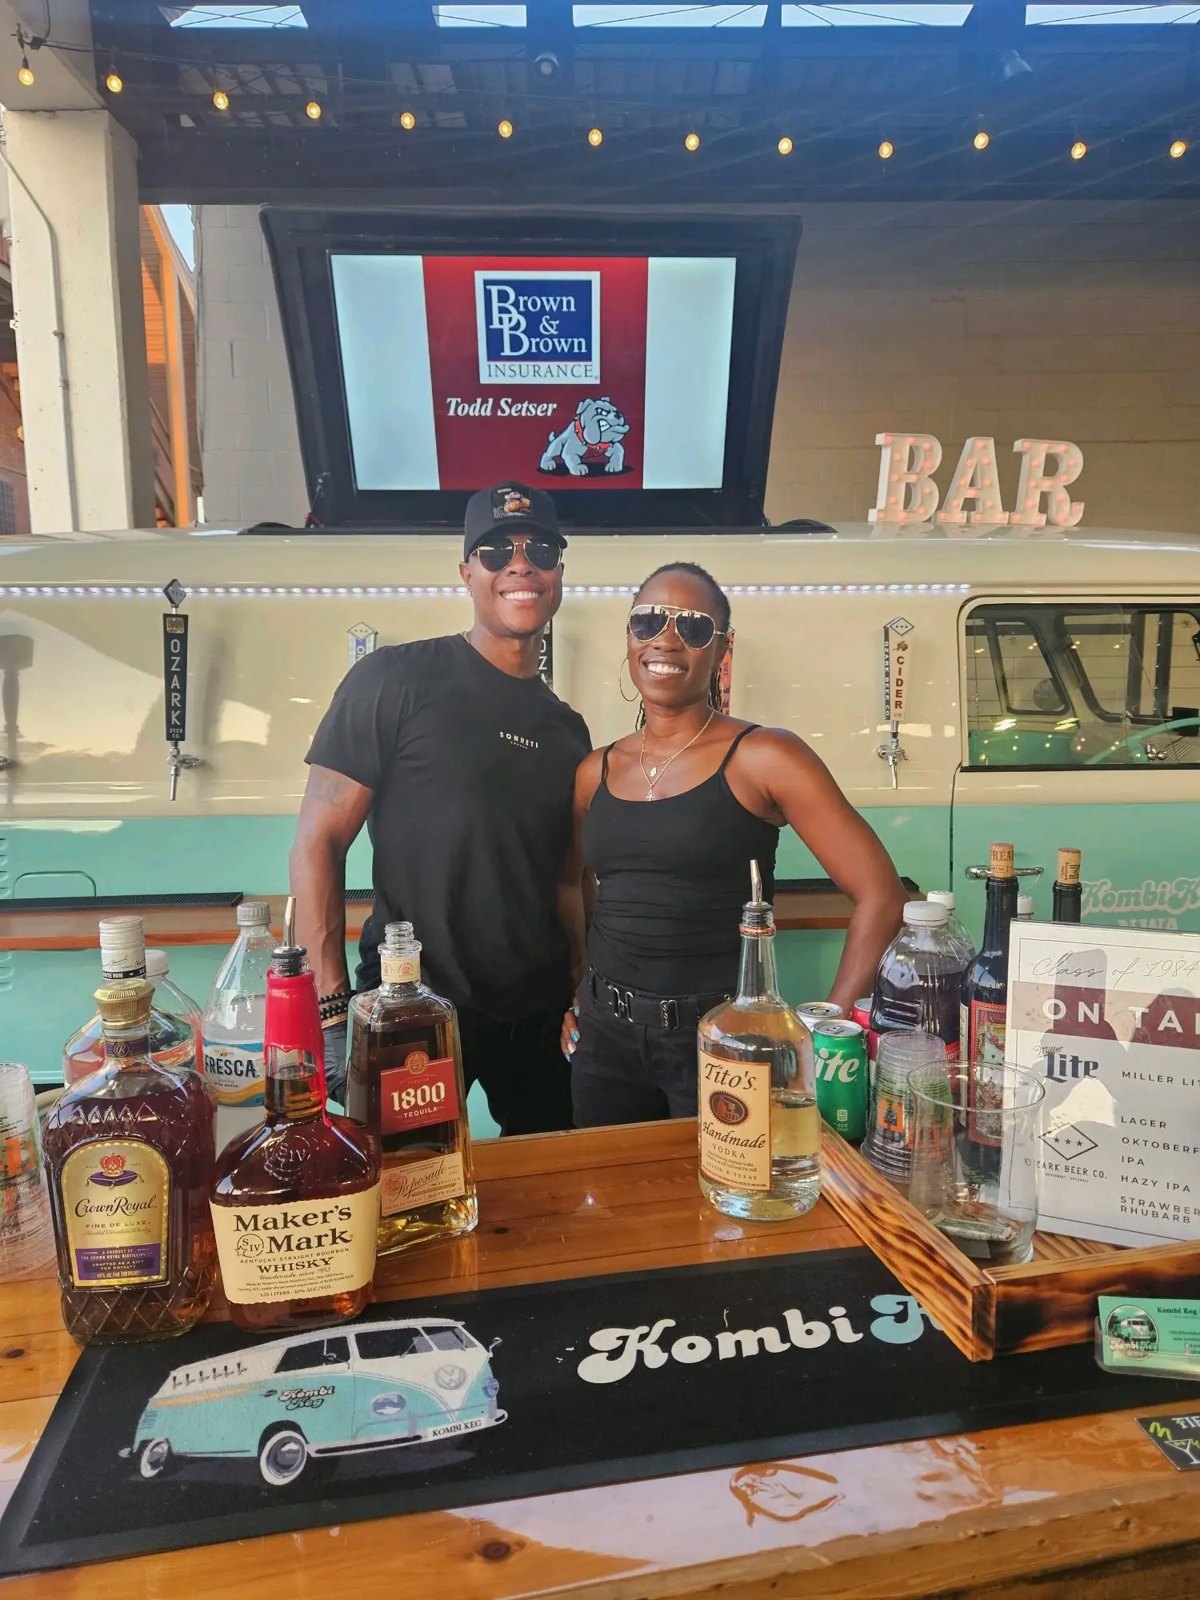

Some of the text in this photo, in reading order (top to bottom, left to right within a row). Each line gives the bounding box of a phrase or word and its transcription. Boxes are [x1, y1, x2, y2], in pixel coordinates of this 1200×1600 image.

[486, 285, 576, 329] Brown
[500, 313, 587, 356] Brown
[539, 315, 560, 335] &
[487, 364, 593, 378] INSURANCE
[446, 398, 557, 417] Todd Setser
[868, 432, 1085, 527] BAR
[170, 639, 181, 725] OZARK
[894, 656, 905, 709] CIDER
[1081, 878, 1167, 916] Kombi
[1032, 951, 1104, 977] Class
[1111, 957, 1140, 989] of
[1042, 998, 1200, 1035] ON TA
[1033, 1045, 1063, 1057] Miller
[205, 1054, 256, 1078] FRESCA
[704, 1062, 756, 1090] Tito's
[814, 1048, 860, 1083] ite
[1044, 1052, 1100, 1083] Lite
[1122, 1071, 1174, 1084] MILLER
[391, 1082, 445, 1111] 1800
[403, 1107, 438, 1118] TEQUILA
[1121, 1116, 1167, 1129] LAGER
[703, 1121, 766, 1149] Handmade
[712, 1143, 746, 1159] VODKA
[1121, 1155, 1145, 1166] IPA
[1064, 1165, 1088, 1177] BEER
[1092, 1169, 1109, 1180] CO.
[1121, 1175, 1191, 1193] HAZY IPA
[75, 1194, 157, 1218] Crown Royal
[1120, 1205, 1191, 1224] RHUBARB
[233, 1205, 352, 1232] Maker's
[266, 1227, 352, 1254] Mark
[257, 1257, 334, 1274] WHISKY
[279, 1253, 313, 1262] STRAIGHT
[316, 1248, 350, 1257] BOURBON
[1183, 1307, 1198, 1315] Keg
[577, 1306, 863, 1384] Kombi
[278, 1385, 335, 1402] Kombi
[286, 1398, 325, 1411] Keg
[432, 1420, 482, 1437] KOMBI KEG
